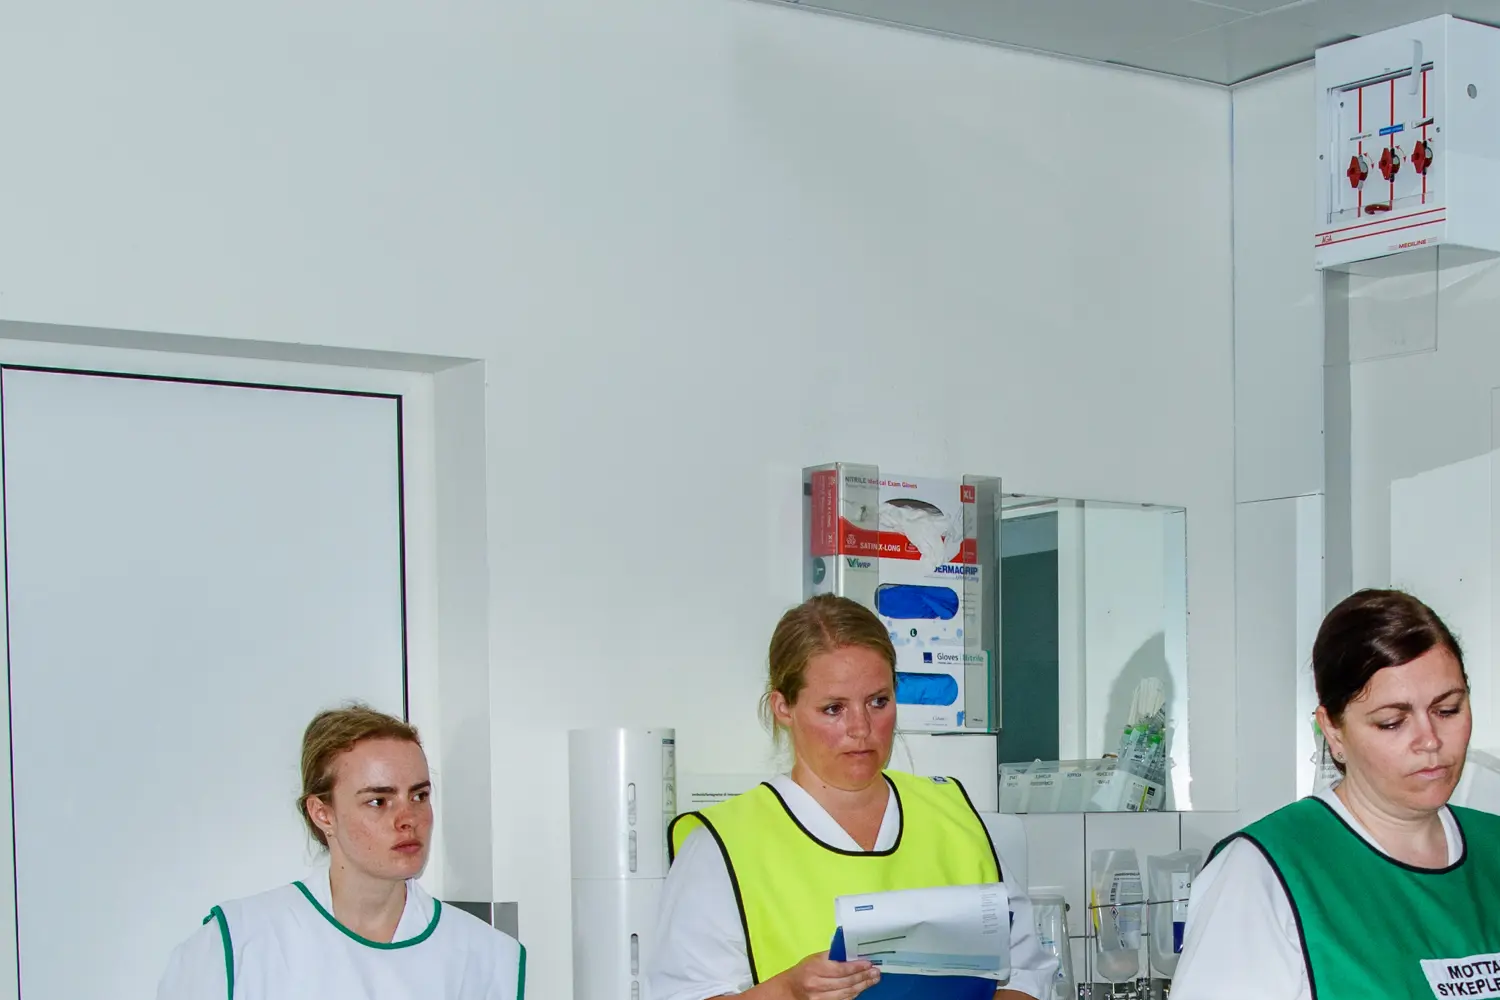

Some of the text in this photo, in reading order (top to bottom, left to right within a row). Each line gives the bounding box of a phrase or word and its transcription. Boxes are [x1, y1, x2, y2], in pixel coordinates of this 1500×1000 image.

[1398, 239, 1427, 249] MEDILINE
[845, 476, 866, 484] NITRILE
[963, 490, 974, 500] XL
[860, 542, 877, 551] SATIN
[856, 561, 871, 569] WRP
[936, 652, 959, 661] Gloves
